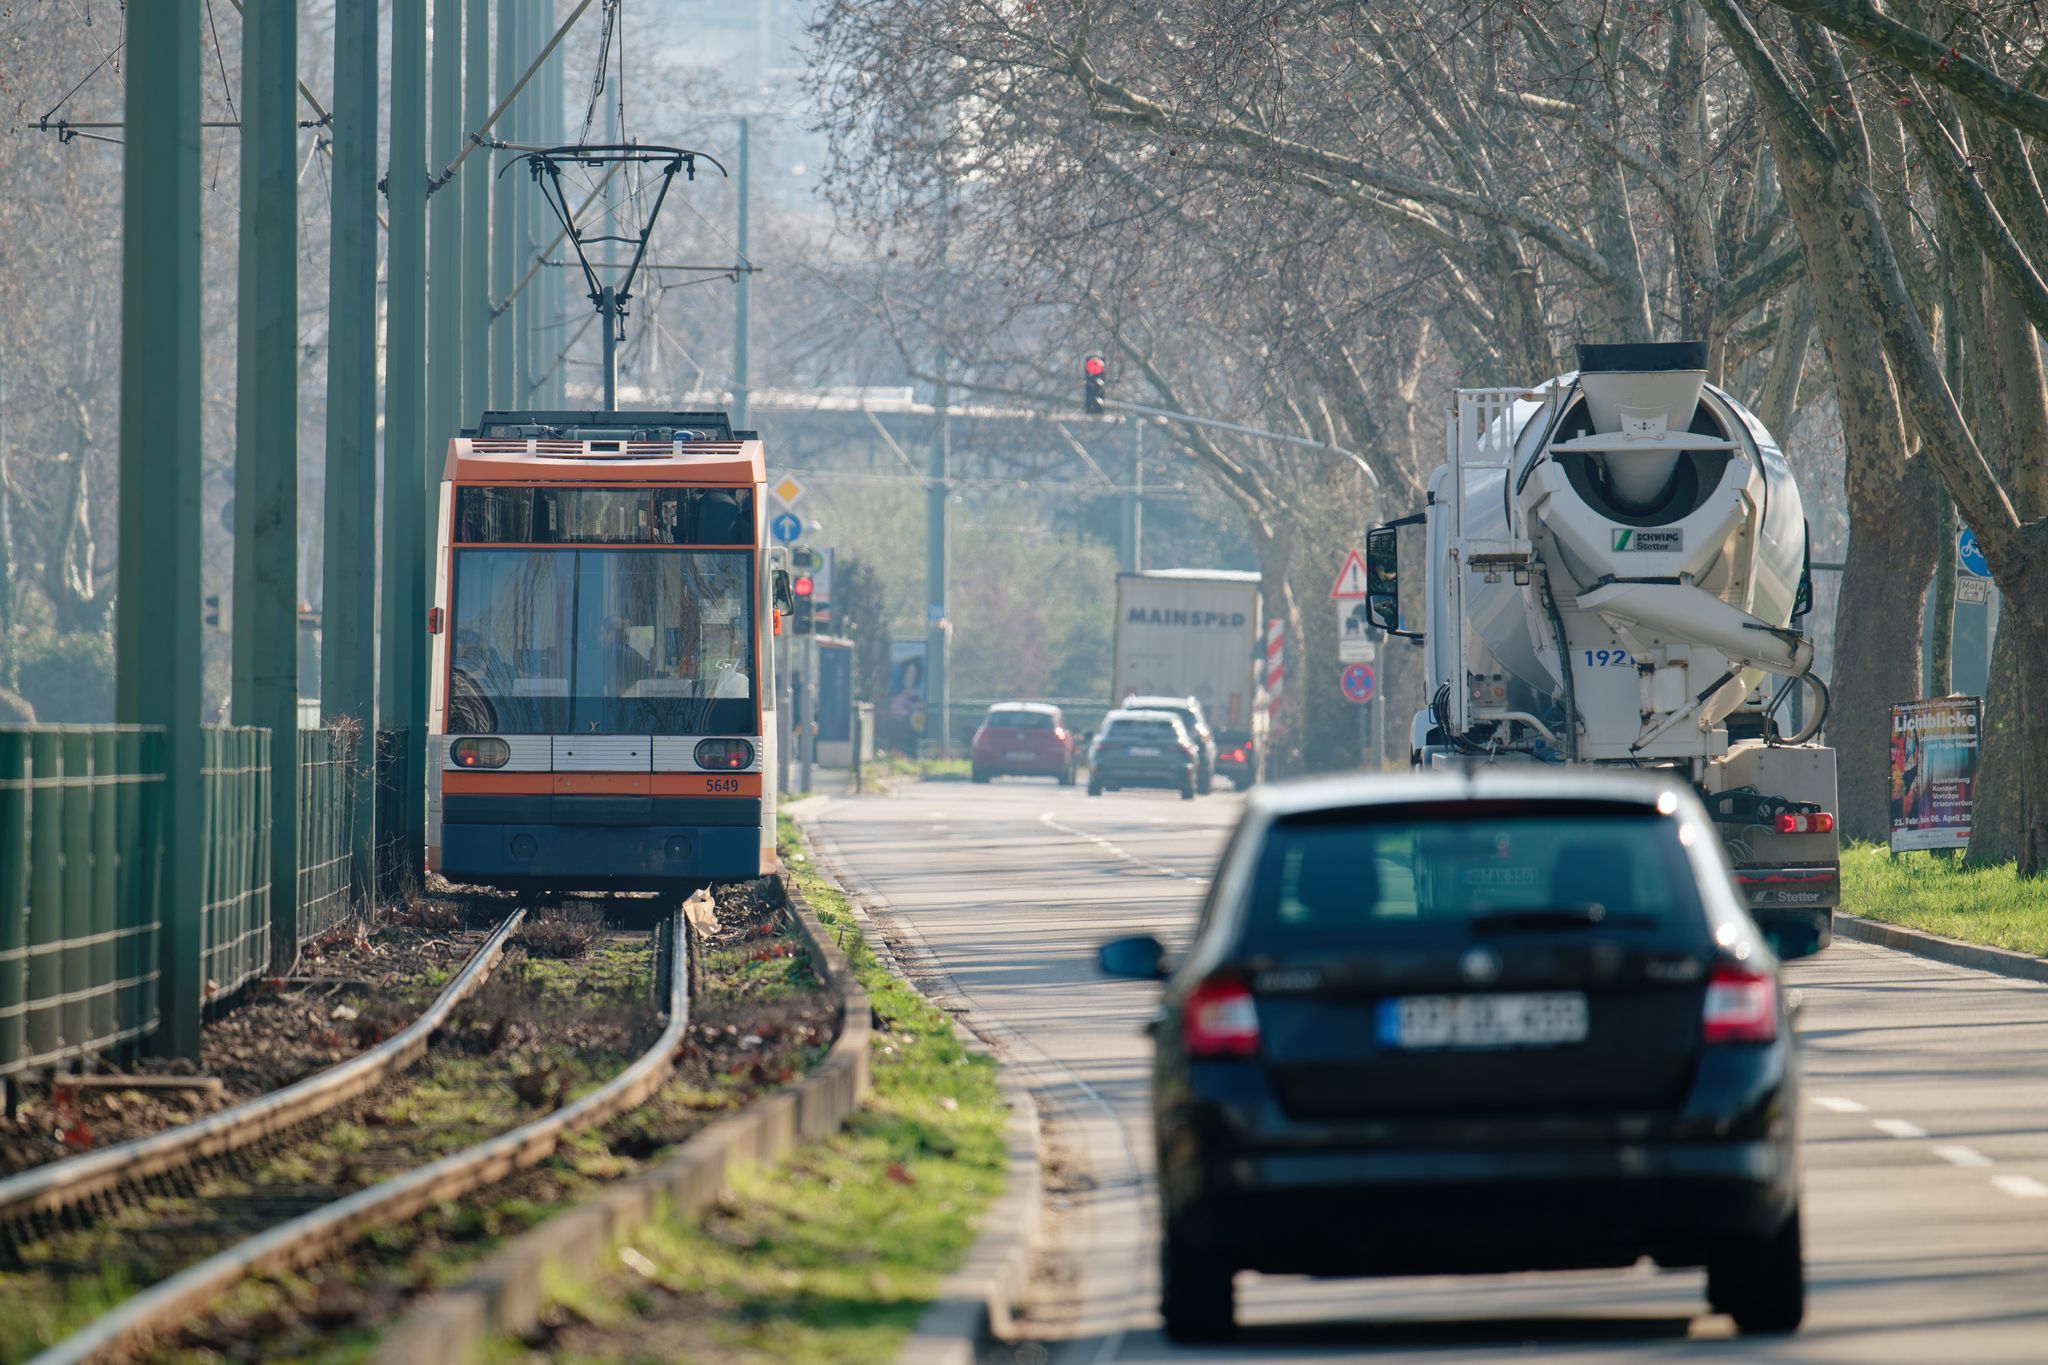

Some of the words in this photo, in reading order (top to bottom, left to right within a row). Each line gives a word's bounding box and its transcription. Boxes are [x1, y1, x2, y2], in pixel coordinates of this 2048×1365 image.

[1894, 711, 1977, 732] Lichtblicke
[706, 779, 739, 792] 5649
[1942, 814, 1960, 823] April
[1777, 891, 1820, 903] Stetter
